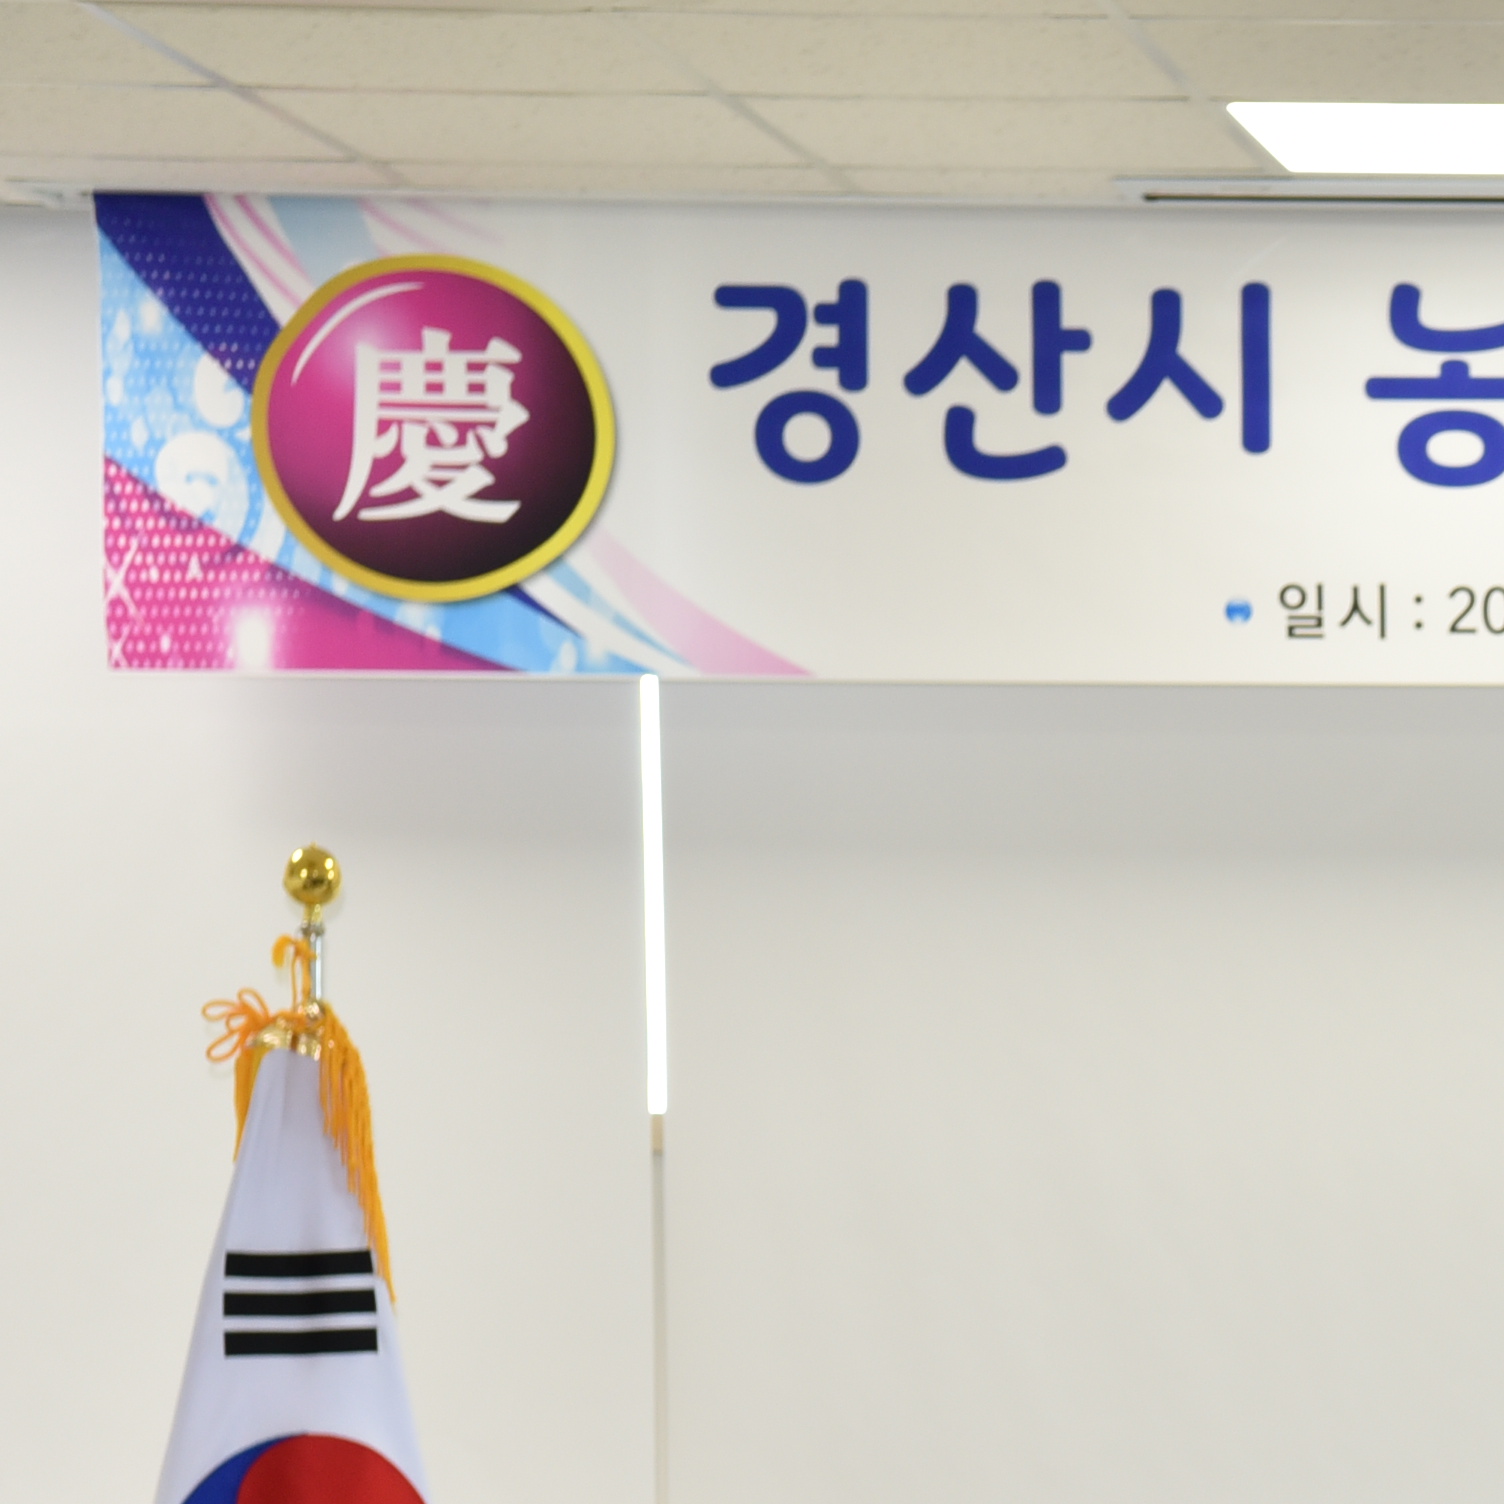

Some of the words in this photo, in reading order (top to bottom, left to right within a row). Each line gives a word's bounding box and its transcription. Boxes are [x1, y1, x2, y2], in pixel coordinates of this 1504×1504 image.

[333, 327, 530, 524] 慶
[709, 279, 1273, 485] 경산시
[1278, 583, 1388, 641] 일시
